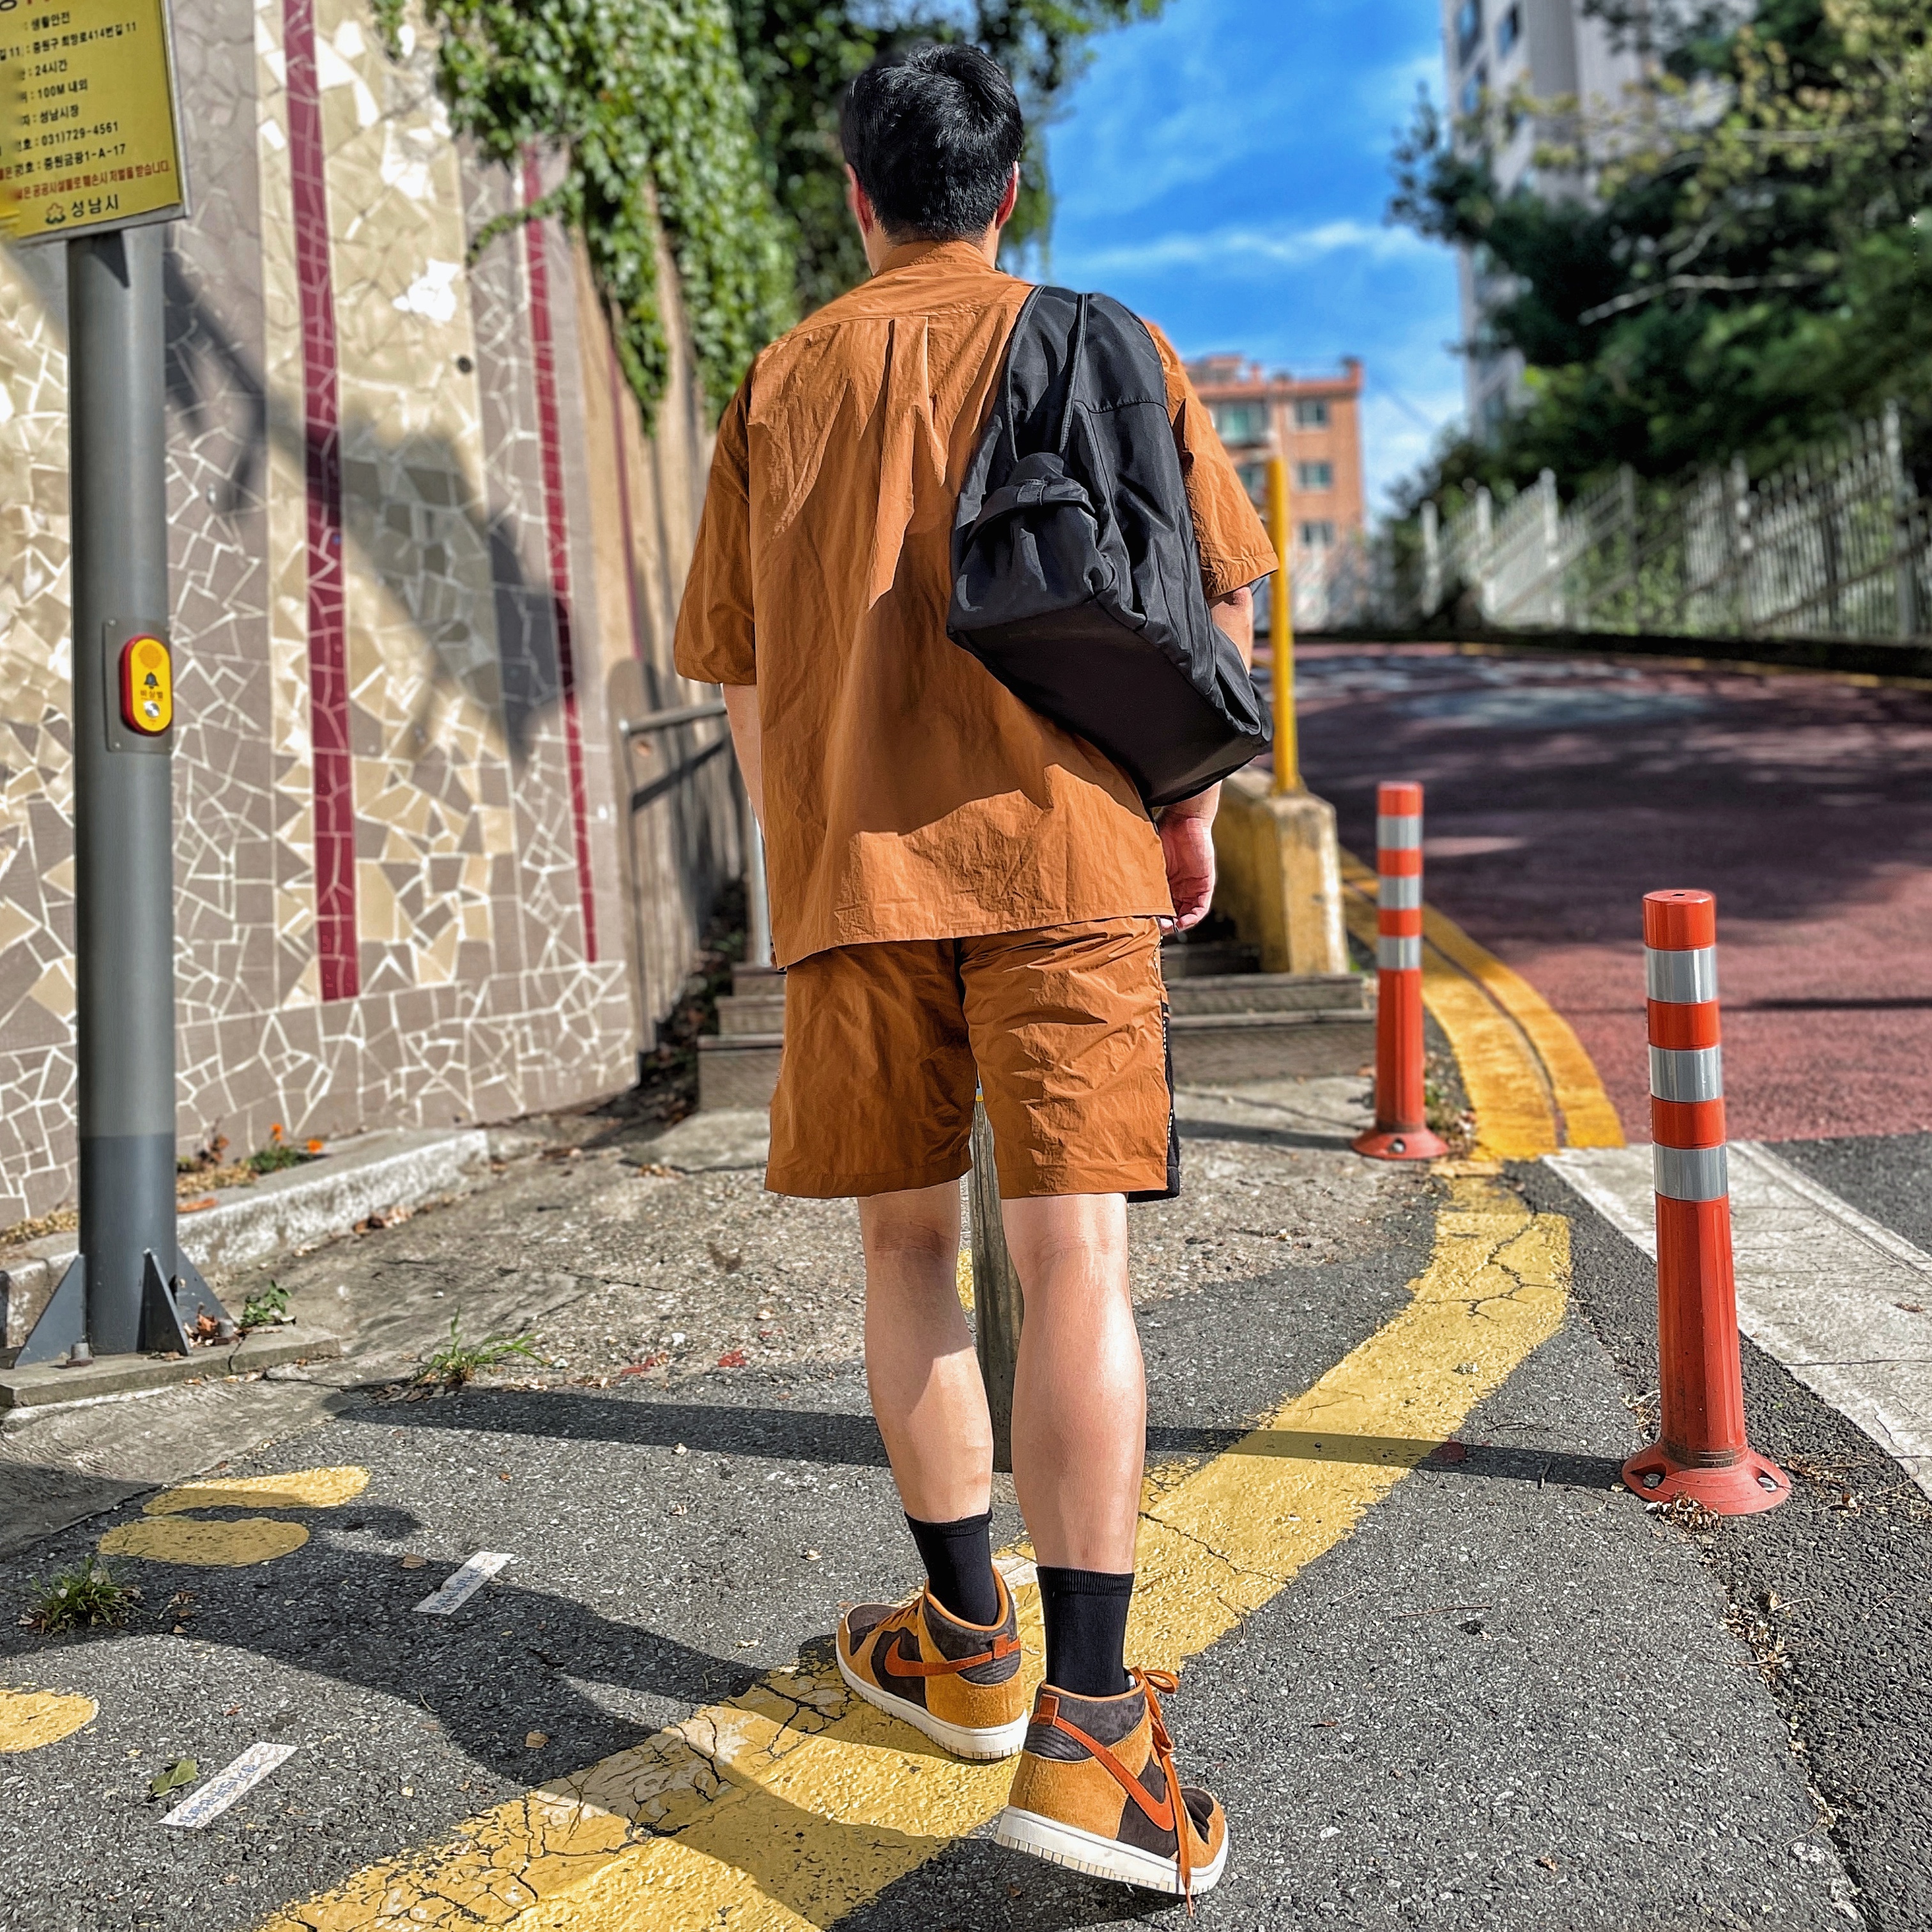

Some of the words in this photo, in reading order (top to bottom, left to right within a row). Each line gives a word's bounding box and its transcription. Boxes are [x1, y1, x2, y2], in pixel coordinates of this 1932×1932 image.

[33, 38, 59, 54] 중원구
[126, 22, 137, 31] 11
[35, 59, 68, 76] 24시간
[38, 84, 65, 99] 100M
[68, 79, 88, 93] 내외
[40, 104, 79, 123] 성남시장
[42, 121, 119, 146] 031)729-4561
[44, 144, 126, 171] 중원금광1-A-17
[71, 194, 119, 218] 성남시
